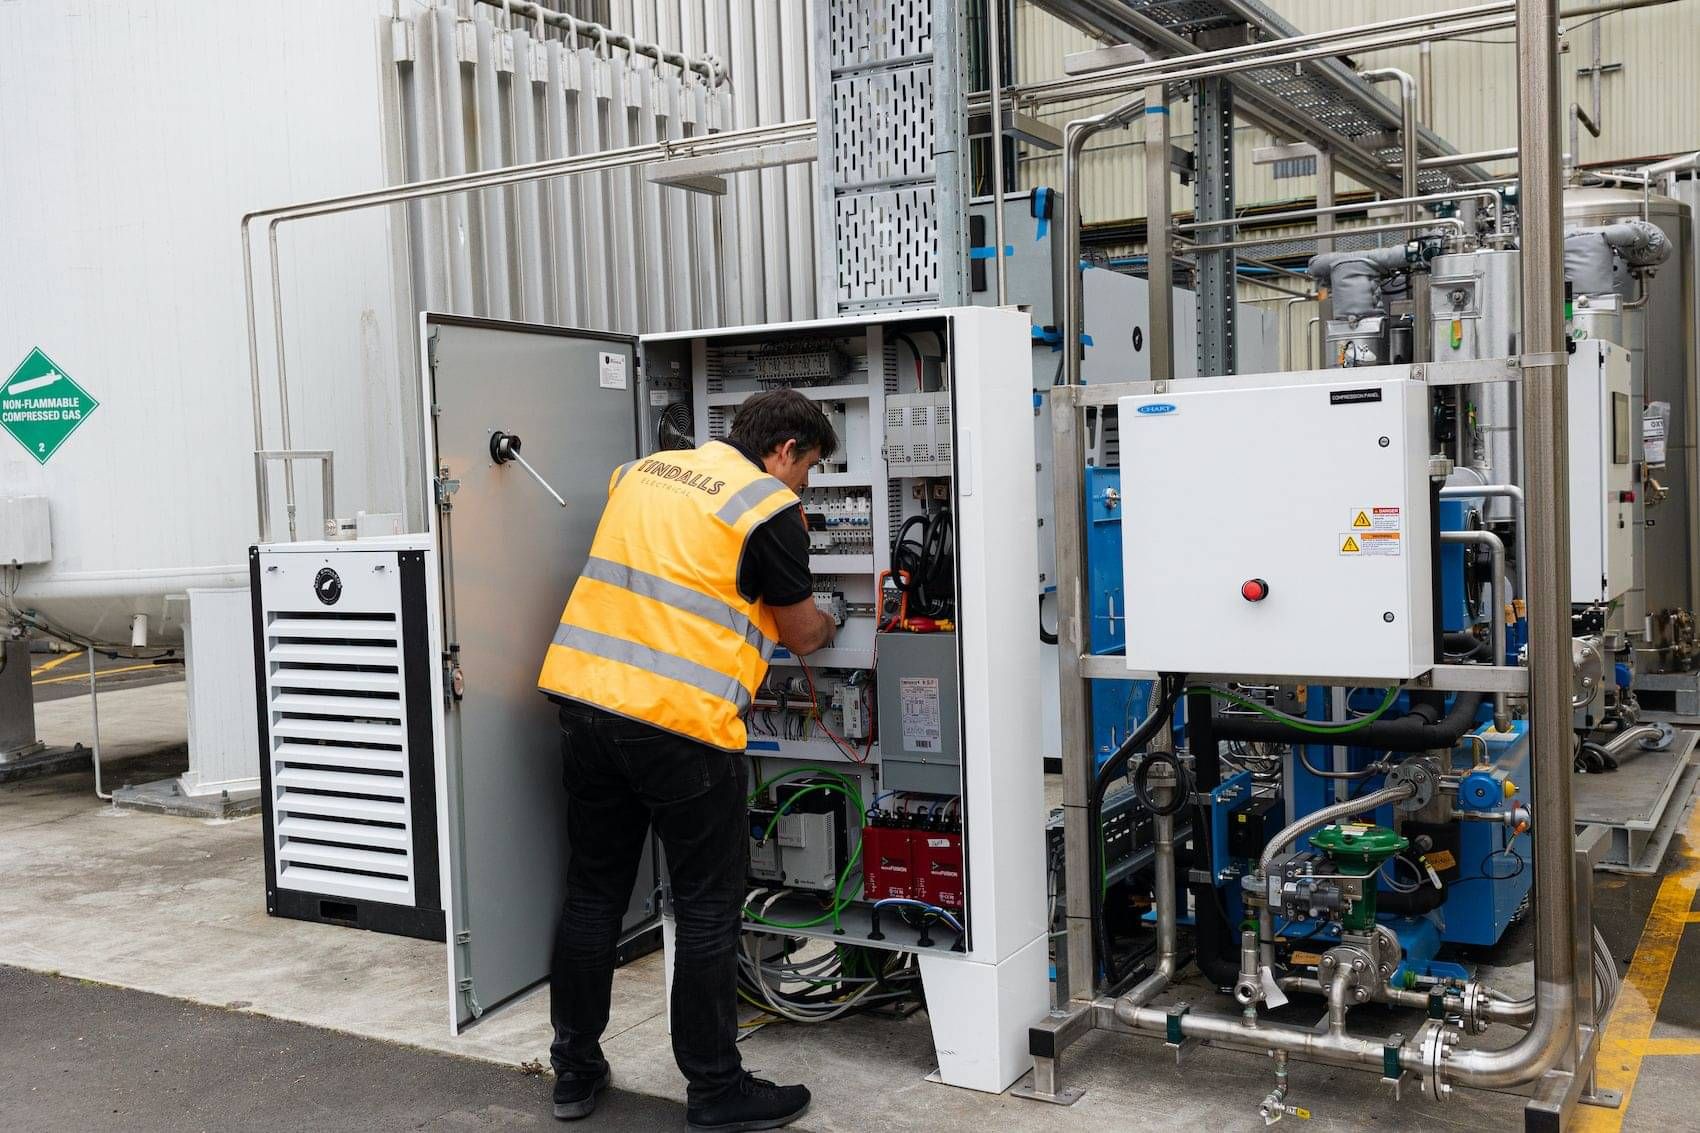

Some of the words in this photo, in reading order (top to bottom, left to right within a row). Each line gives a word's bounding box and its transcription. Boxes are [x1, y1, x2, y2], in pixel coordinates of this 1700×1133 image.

[2, 397, 79, 410] NON-FLAMMABLE
[2, 411, 60, 422] COMPRESSED
[62, 410, 81, 420] GAS
[38, 442, 45, 452] 2
[637, 459, 726, 495] TINDALLS
